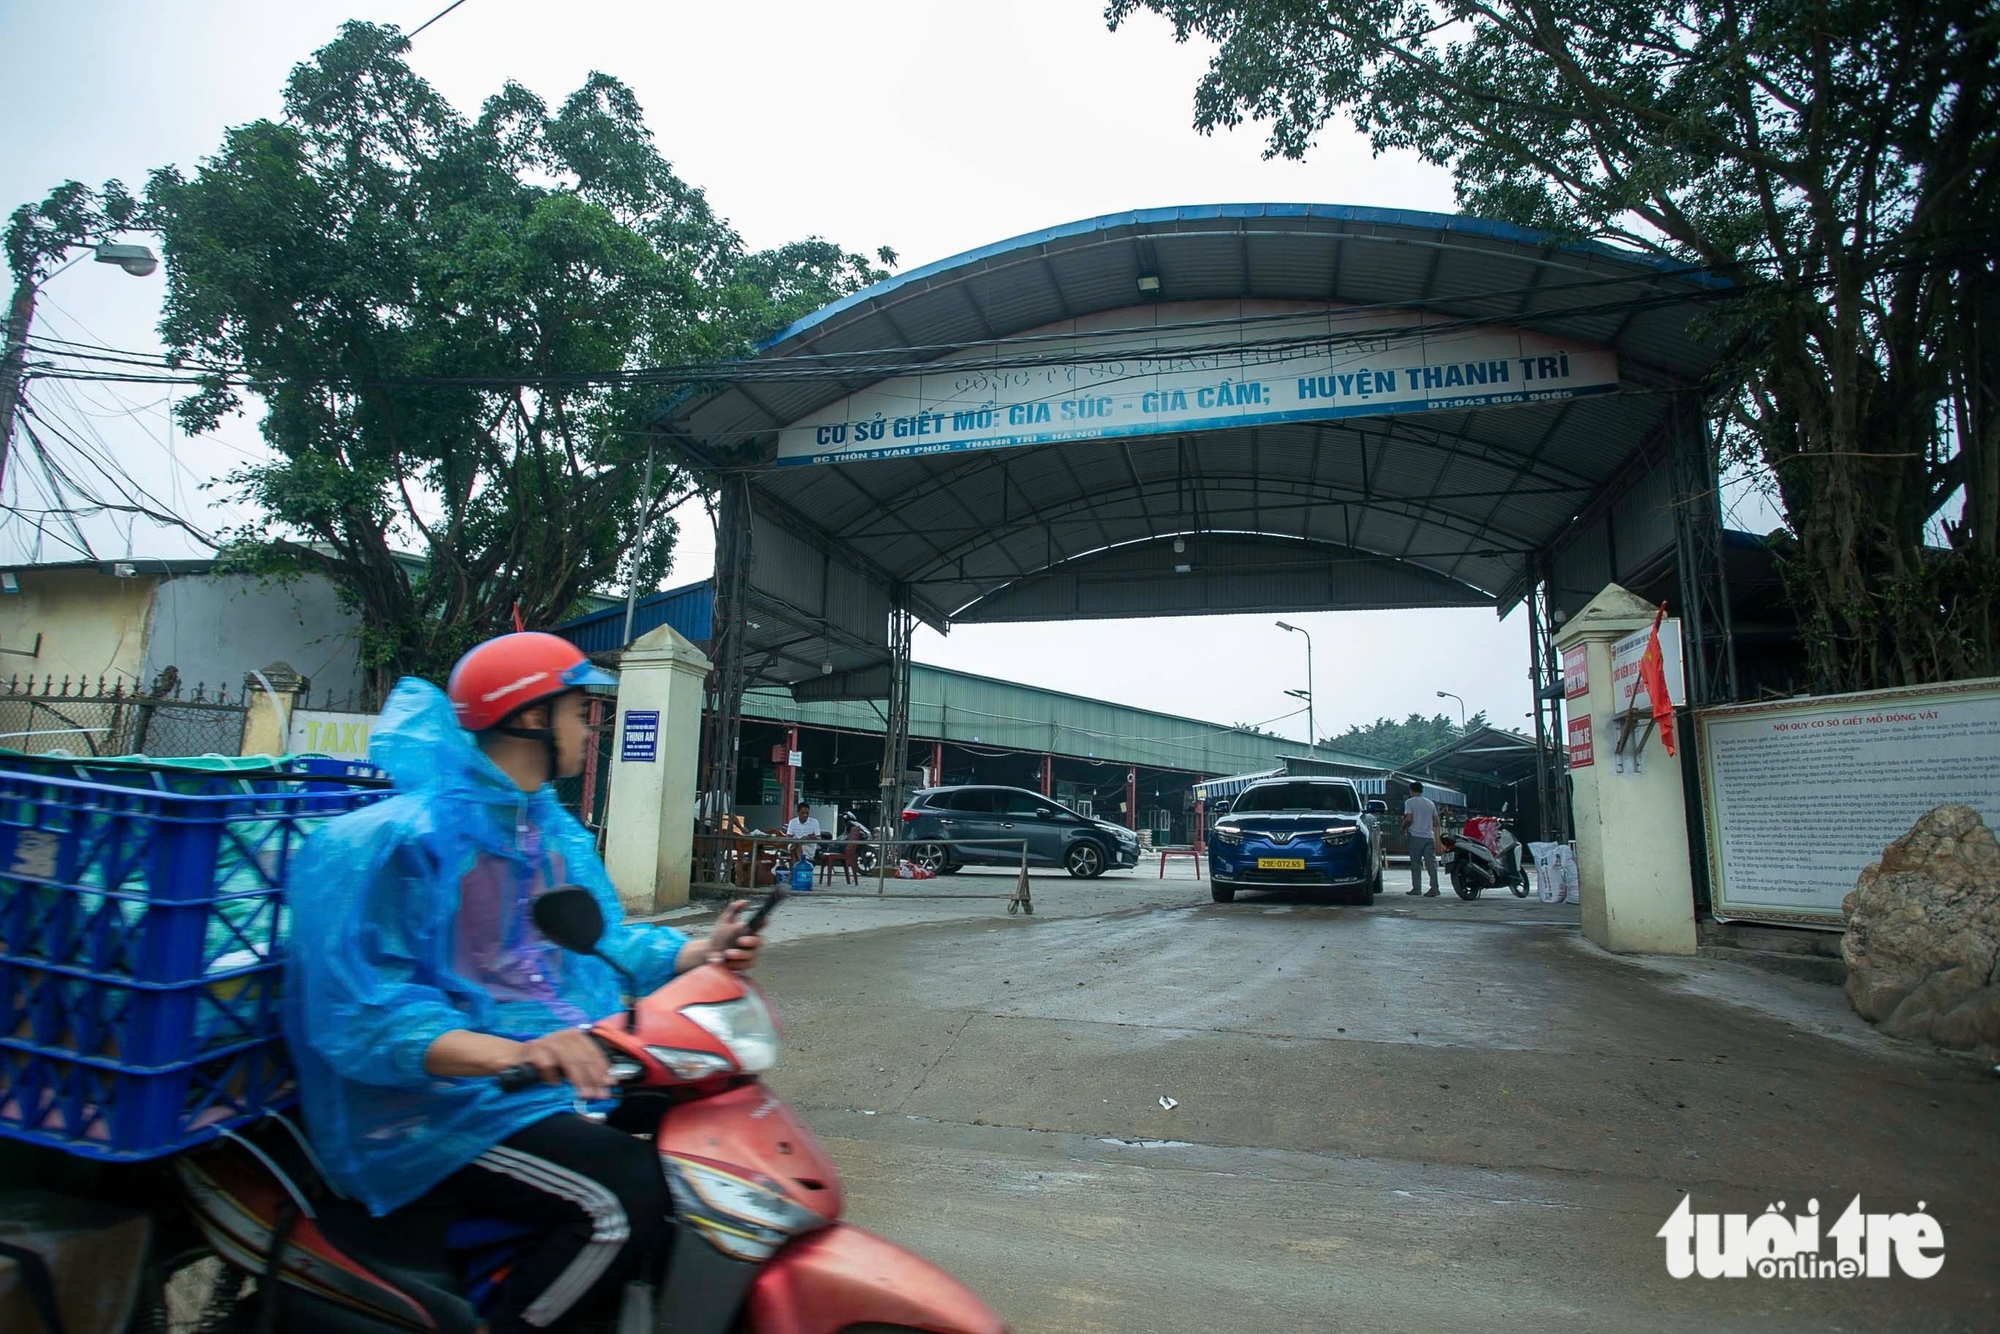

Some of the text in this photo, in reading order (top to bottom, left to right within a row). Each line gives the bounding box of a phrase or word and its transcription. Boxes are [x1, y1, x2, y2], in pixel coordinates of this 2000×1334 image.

[817, 423, 848, 445] CƠ
[854, 412, 887, 442] SỞ
[893, 408, 945, 437] GIẾT
[1009, 402, 1051, 426] GIA
[1061, 394, 1113, 420] SÚC
[1141, 389, 1188, 414] GIA
[1298, 368, 1396, 399] HUYỆN
[1405, 361, 1509, 390] THANH
[1519, 351, 1570, 380] TRÌ
[834, 451, 868, 462] THÔN
[965, 438, 1011, 449] THANH
[1773, 723, 1788, 732] NỘI
[1826, 718, 1839, 727] SỞ
[1841, 716, 1862, 726] GIẾT
[1865, 713, 1883, 724] MỔ
[1885, 712, 1915, 723] ĐỘNG
[1918, 710, 1938, 721] VẬT
[306, 721, 369, 754] TAXI
